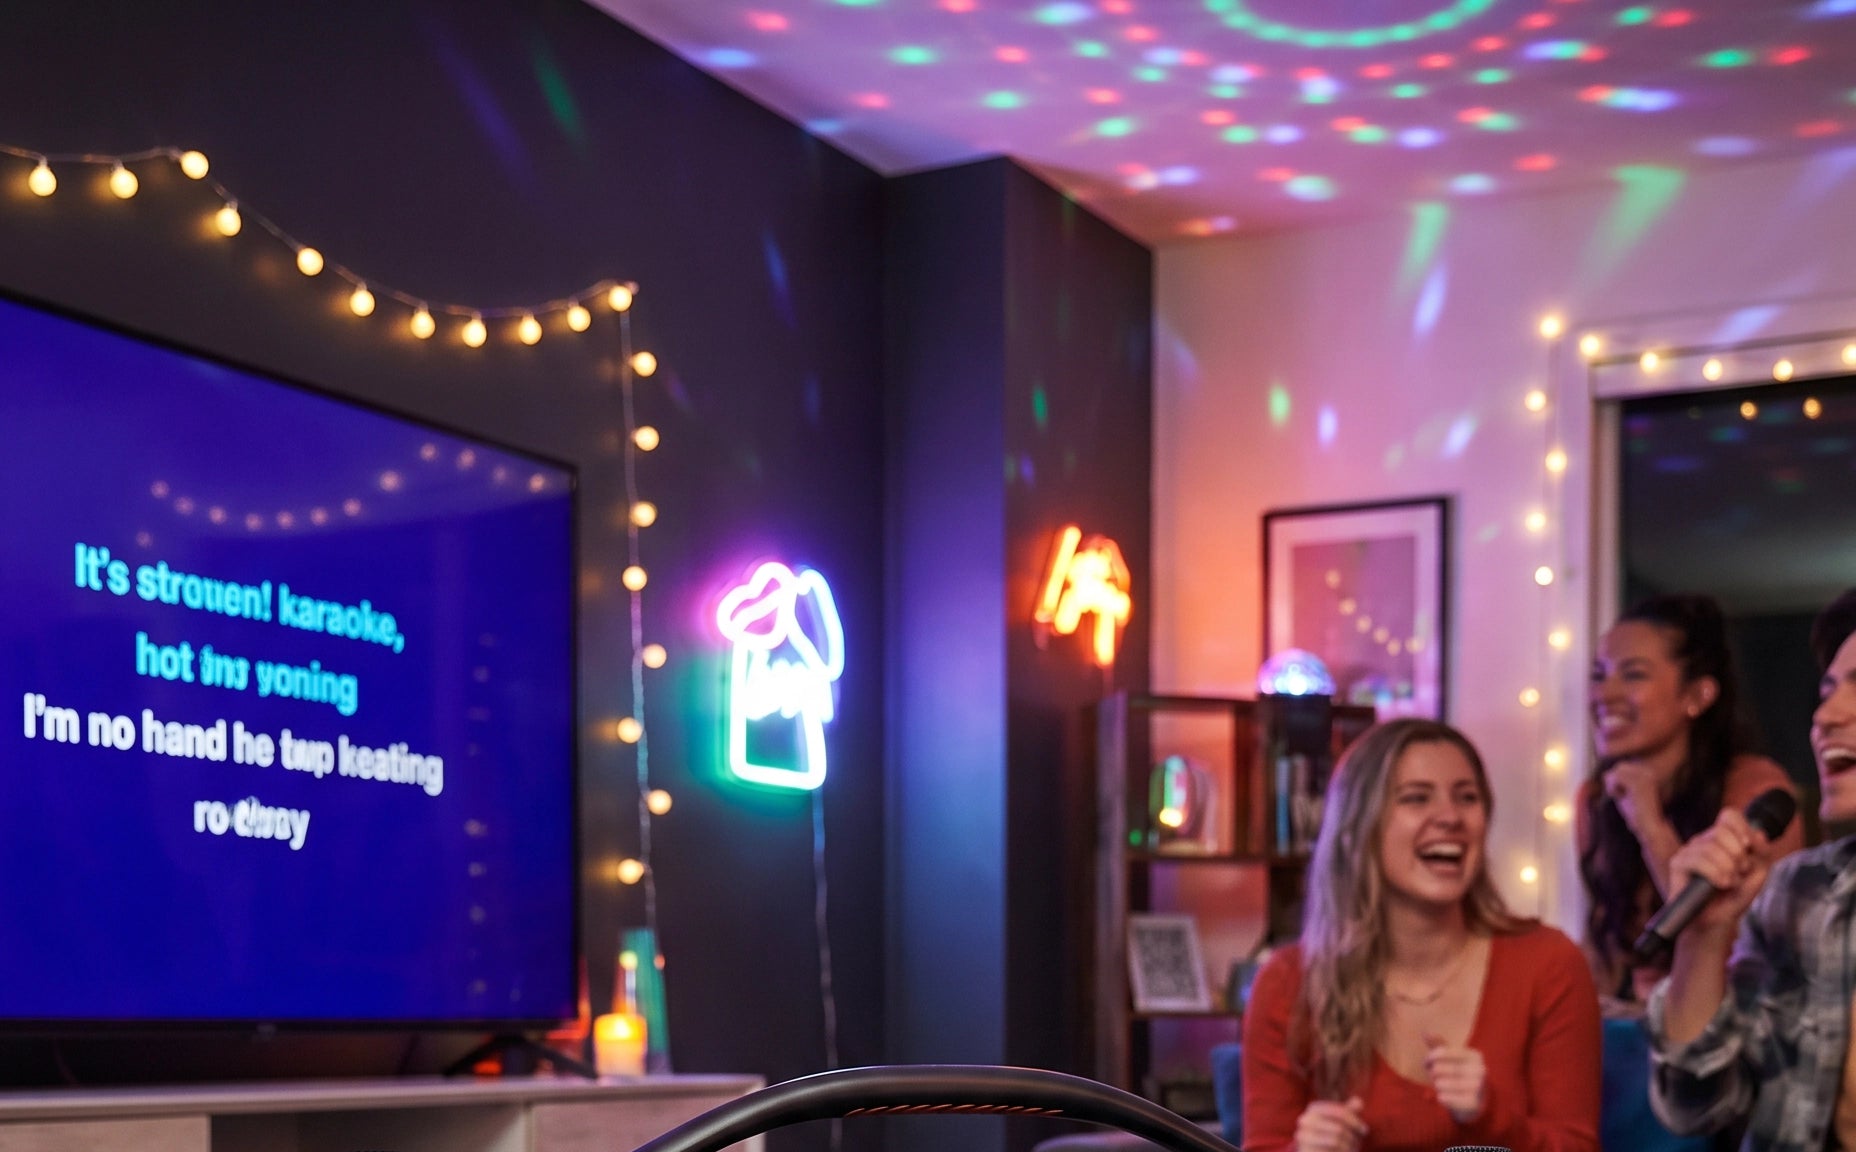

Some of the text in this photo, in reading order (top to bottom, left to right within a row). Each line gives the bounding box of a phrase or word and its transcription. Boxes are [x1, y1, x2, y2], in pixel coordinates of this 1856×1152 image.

[75, 542, 131, 596] It's
[278, 583, 405, 654] karaoke,
[136, 631, 195, 683] hot
[24, 692, 80, 744] I'm
[88, 711, 136, 750] no
[142, 708, 227, 762] hand
[233, 720, 275, 768] he
